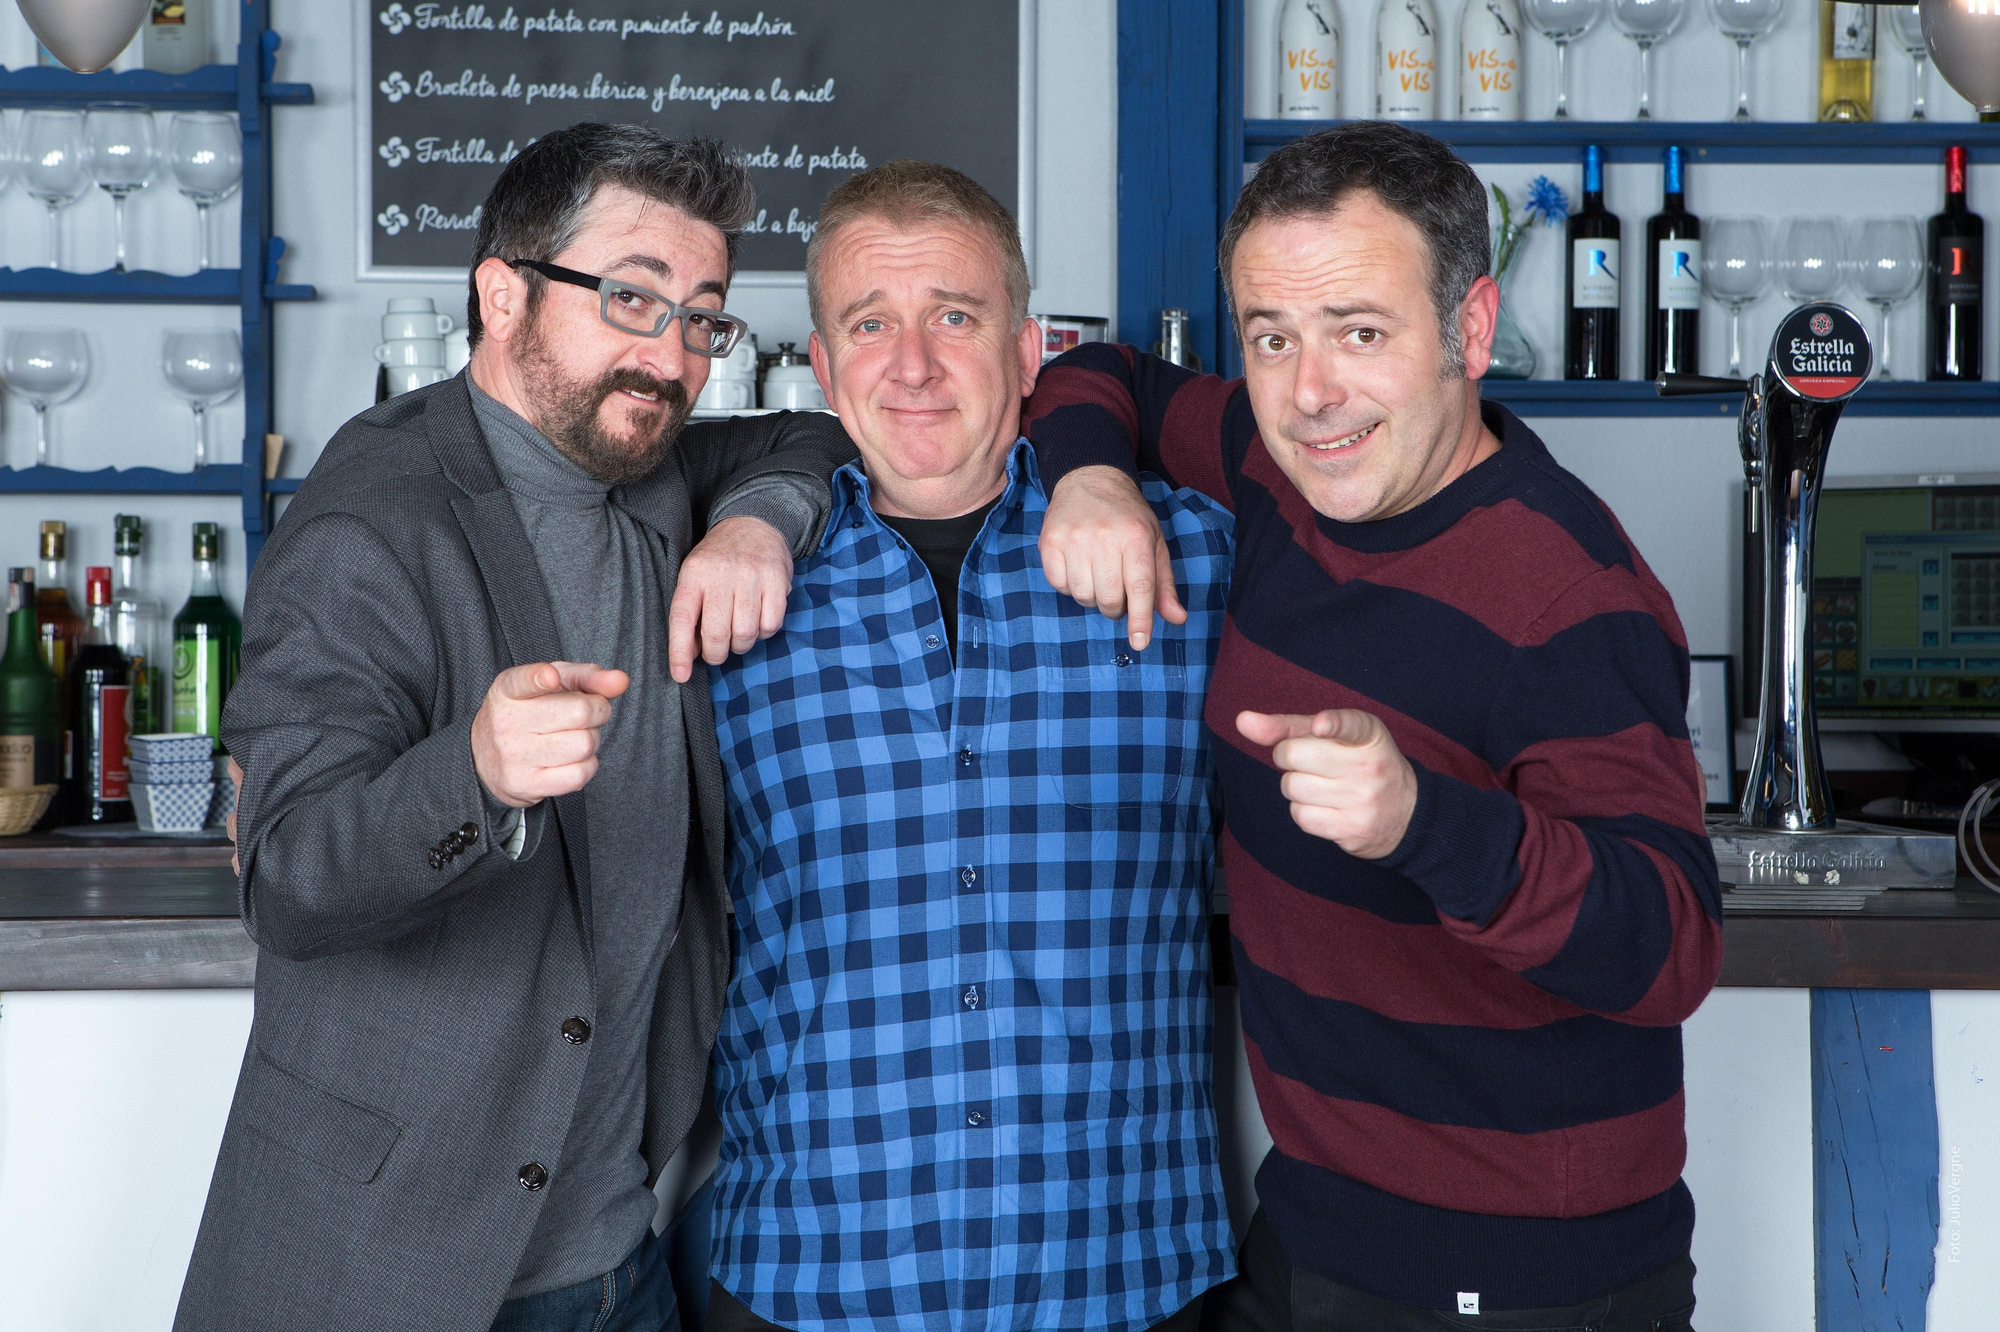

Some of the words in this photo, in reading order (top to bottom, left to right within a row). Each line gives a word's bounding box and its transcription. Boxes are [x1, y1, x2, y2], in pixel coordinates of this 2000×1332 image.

[414, 3, 495, 31] Tortilla
[499, 6, 519, 31] de
[523, 8, 584, 38] patata
[588, 17, 618, 33] con
[621, 10, 701, 40] pimiento
[703, 10, 724, 35] de
[415, 69, 498, 97] Brocheta
[501, 73, 522, 98] de
[526, 83, 580, 105] presa
[583, 72, 648, 99] ibérica
[651, 86, 667, 112] y
[668, 73, 751, 110] berenjena
[754, 87, 767, 101] a
[770, 76, 792, 102] la
[794, 77, 836, 103] miel
[1300, 70, 1331, 92] VIS
[1400, 70, 1431, 92] VIS
[1480, 71, 1512, 93] VIS
[415, 136, 497, 164] Tortilla
[783, 144, 804, 169] de
[808, 145, 869, 176] patata
[415, 203, 483, 233] Revuel
[742, 208, 768, 234] al
[771, 220, 784, 234] a
[1587, 249, 1618, 280] R
[1670, 250, 1699, 282] R
[1789, 338, 1855, 355] Estrella
[1792, 355, 1852, 373] Galicia
